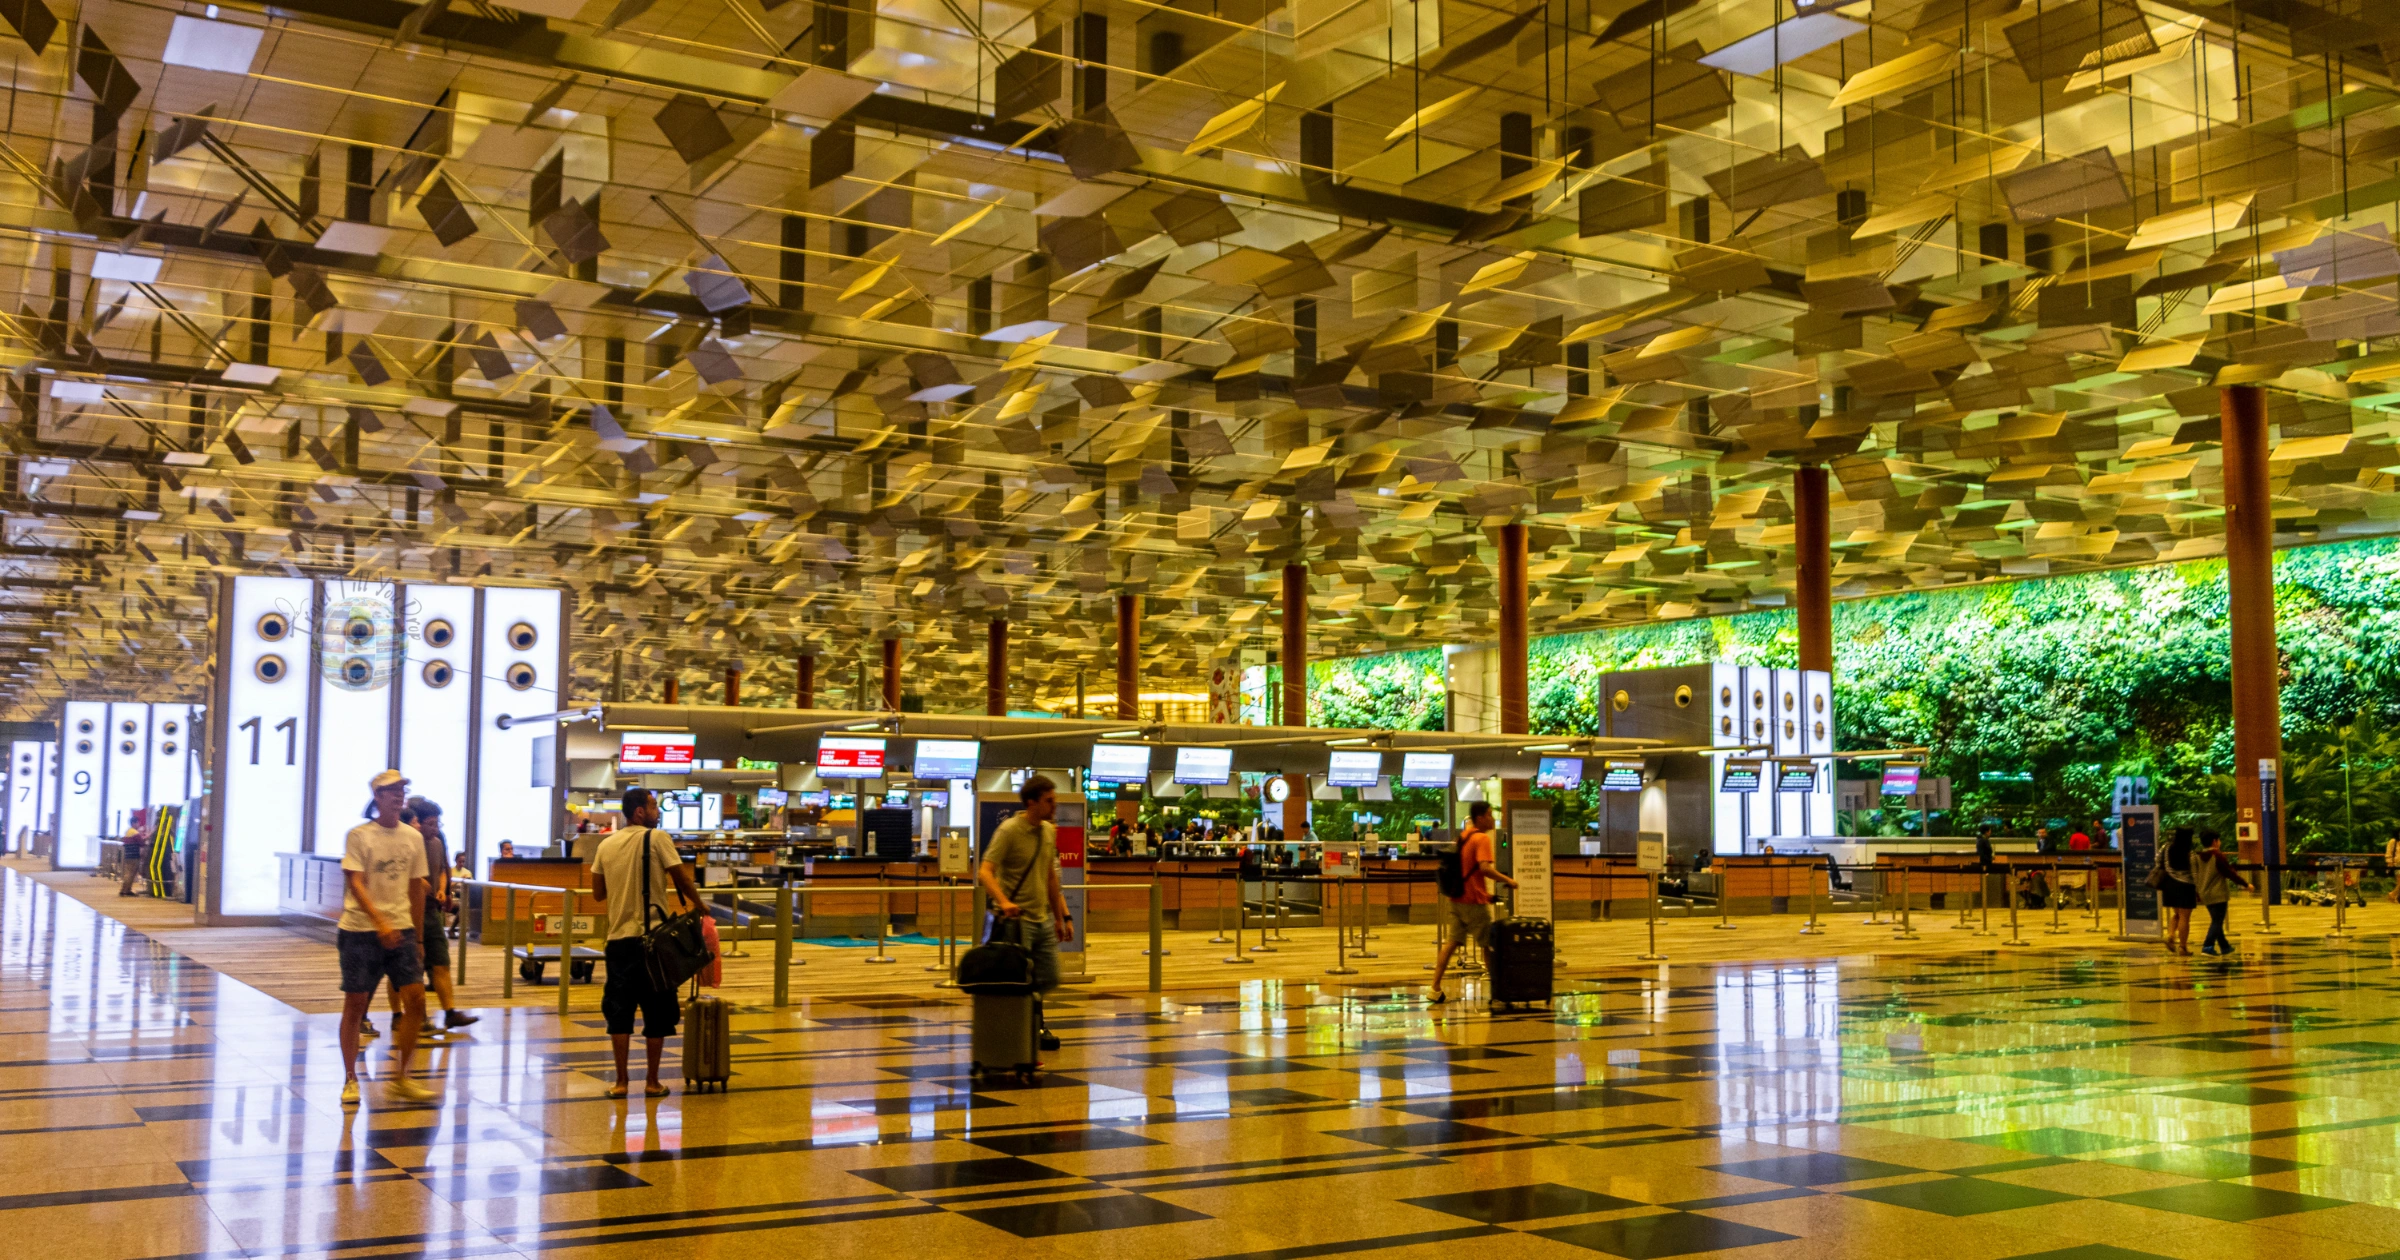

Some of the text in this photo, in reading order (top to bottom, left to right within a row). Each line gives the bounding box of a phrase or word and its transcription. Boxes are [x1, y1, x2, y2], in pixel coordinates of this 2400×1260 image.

[238, 716, 297, 766] 11
[73, 770, 91, 795] 9
[18, 786, 31, 803] 7
[708, 797, 716, 811] 7
[1059, 852, 1080, 860] RITY
[553, 920, 588, 930] data
